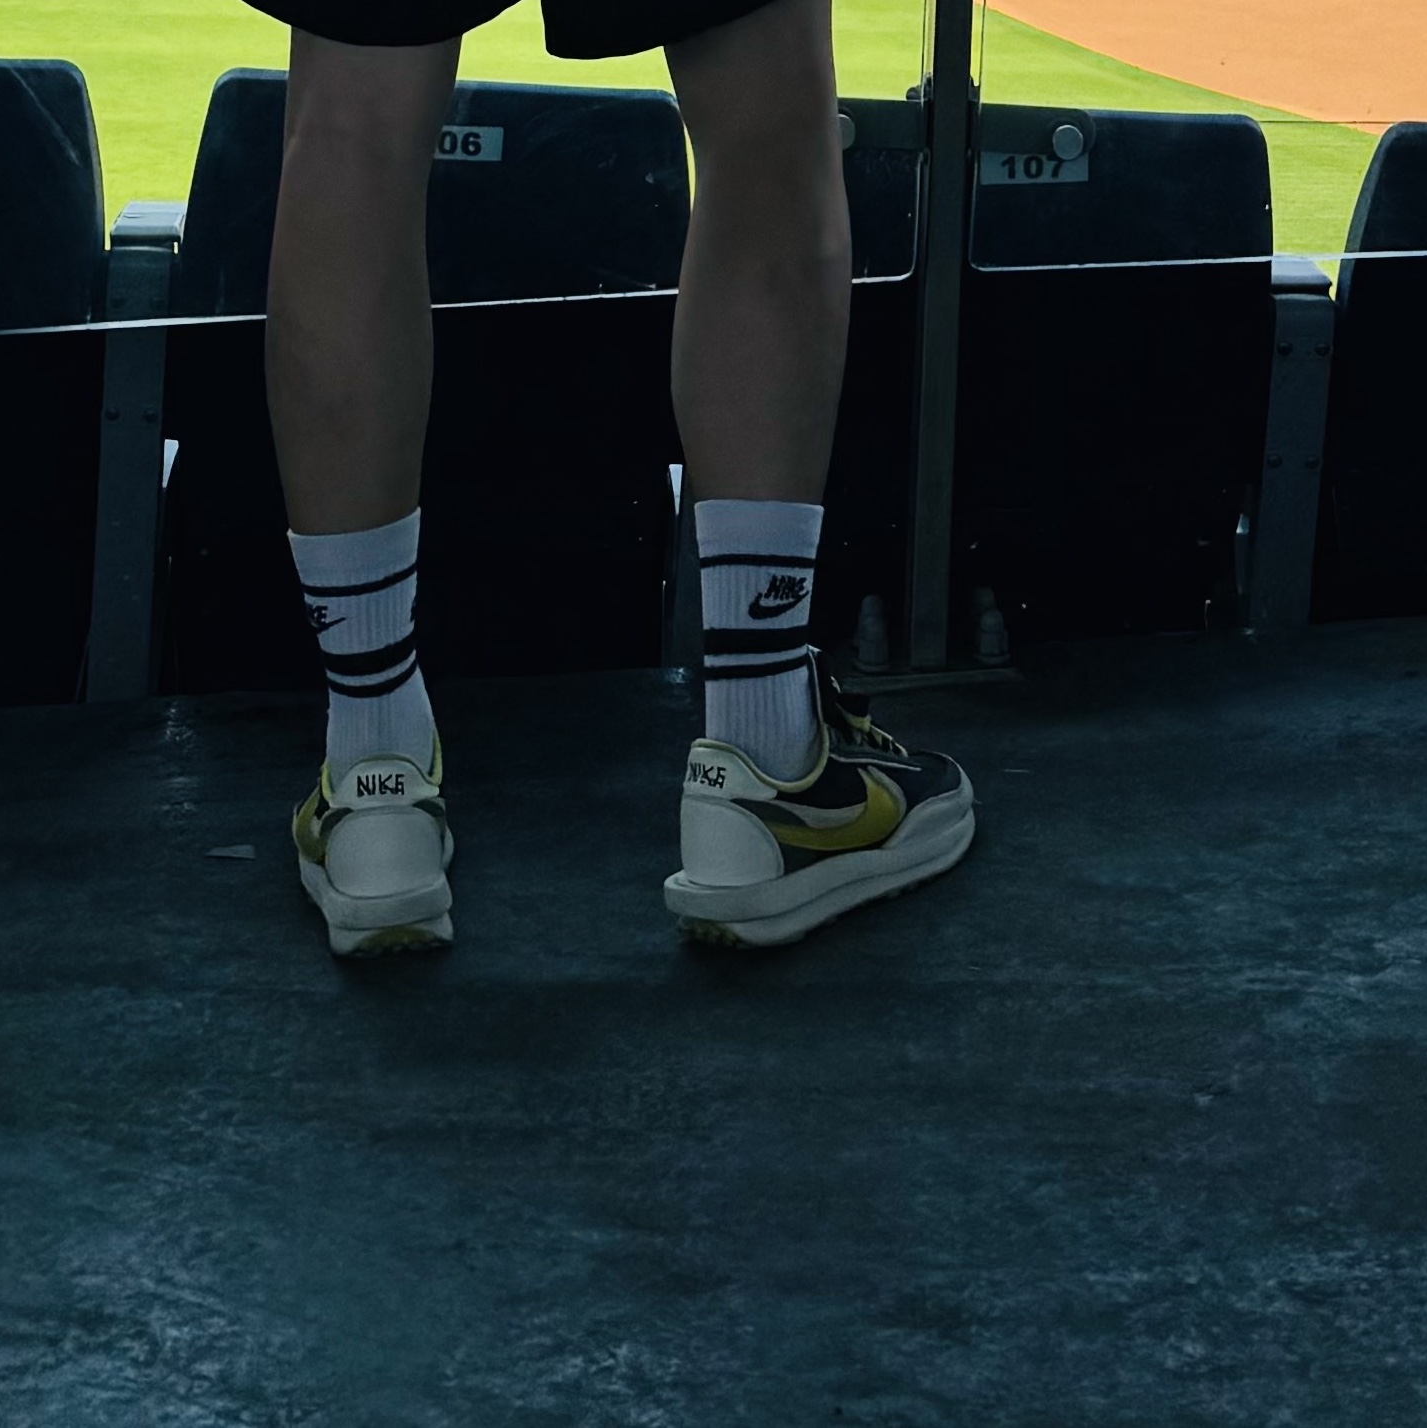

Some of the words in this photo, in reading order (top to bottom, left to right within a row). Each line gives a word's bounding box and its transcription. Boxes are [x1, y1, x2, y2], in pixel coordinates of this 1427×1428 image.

[435, 129, 483, 158] 06
[1000, 154, 1065, 181] 107
[764, 574, 808, 601] NIKE
